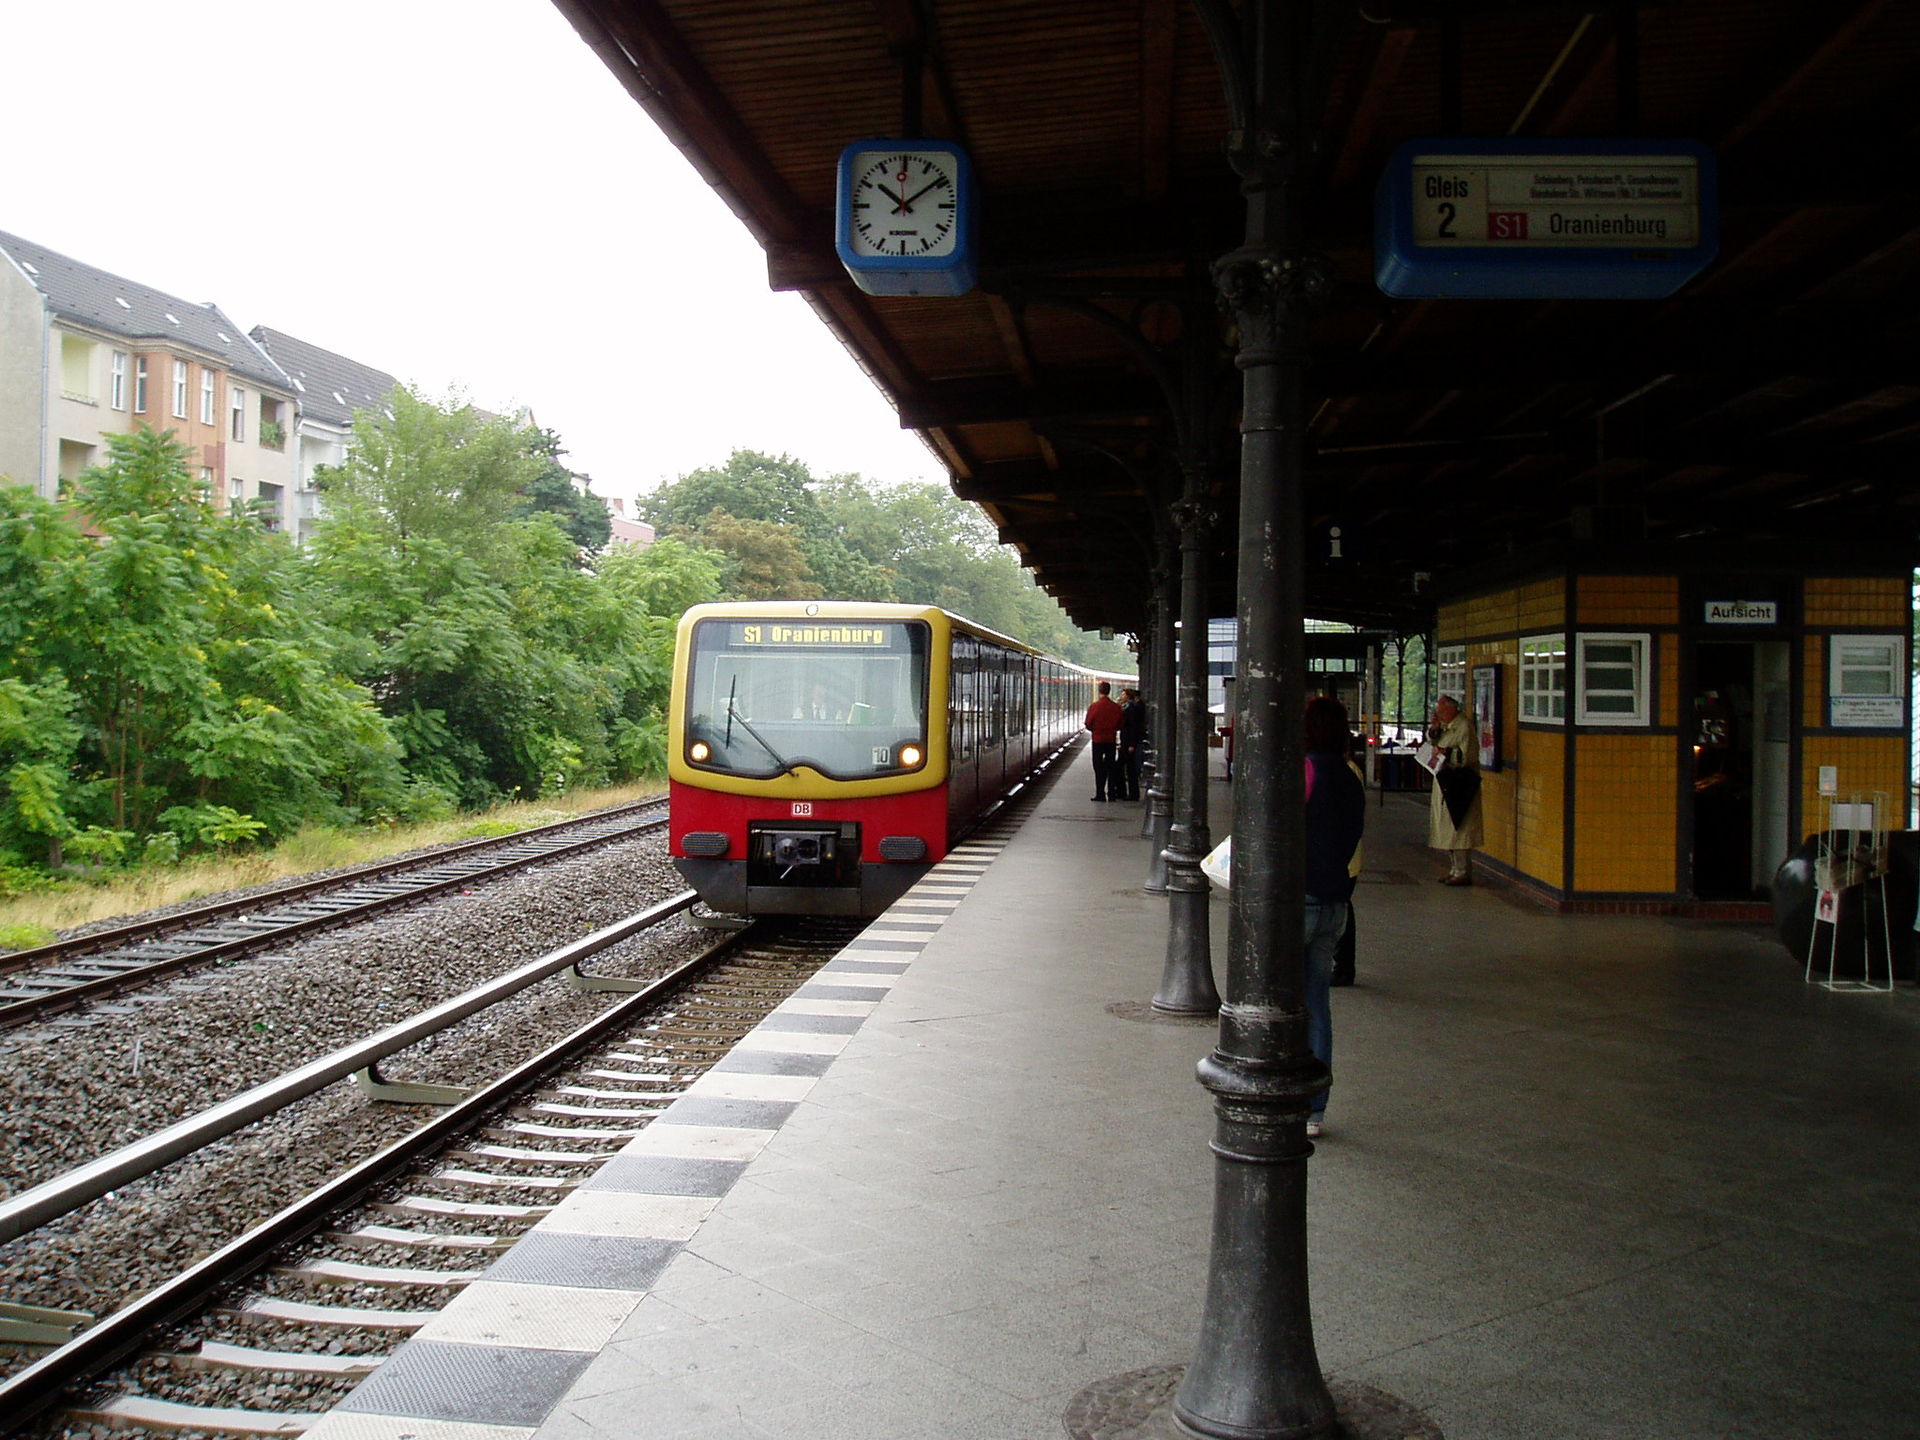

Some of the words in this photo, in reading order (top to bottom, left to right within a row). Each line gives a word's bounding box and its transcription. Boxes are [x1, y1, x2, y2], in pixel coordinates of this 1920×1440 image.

[1426, 176, 1468, 198] Gleis
[1437, 202, 1457, 237] 2
[1495, 214, 1521, 237] S1
[1550, 212, 1667, 238] Oranienburg
[1711, 606, 1771, 619] Aufsicht
[744, 625, 762, 643] S1
[771, 626, 884, 645] Oranienburg
[873, 748, 888, 763] 10
[794, 803, 810, 814] DB
